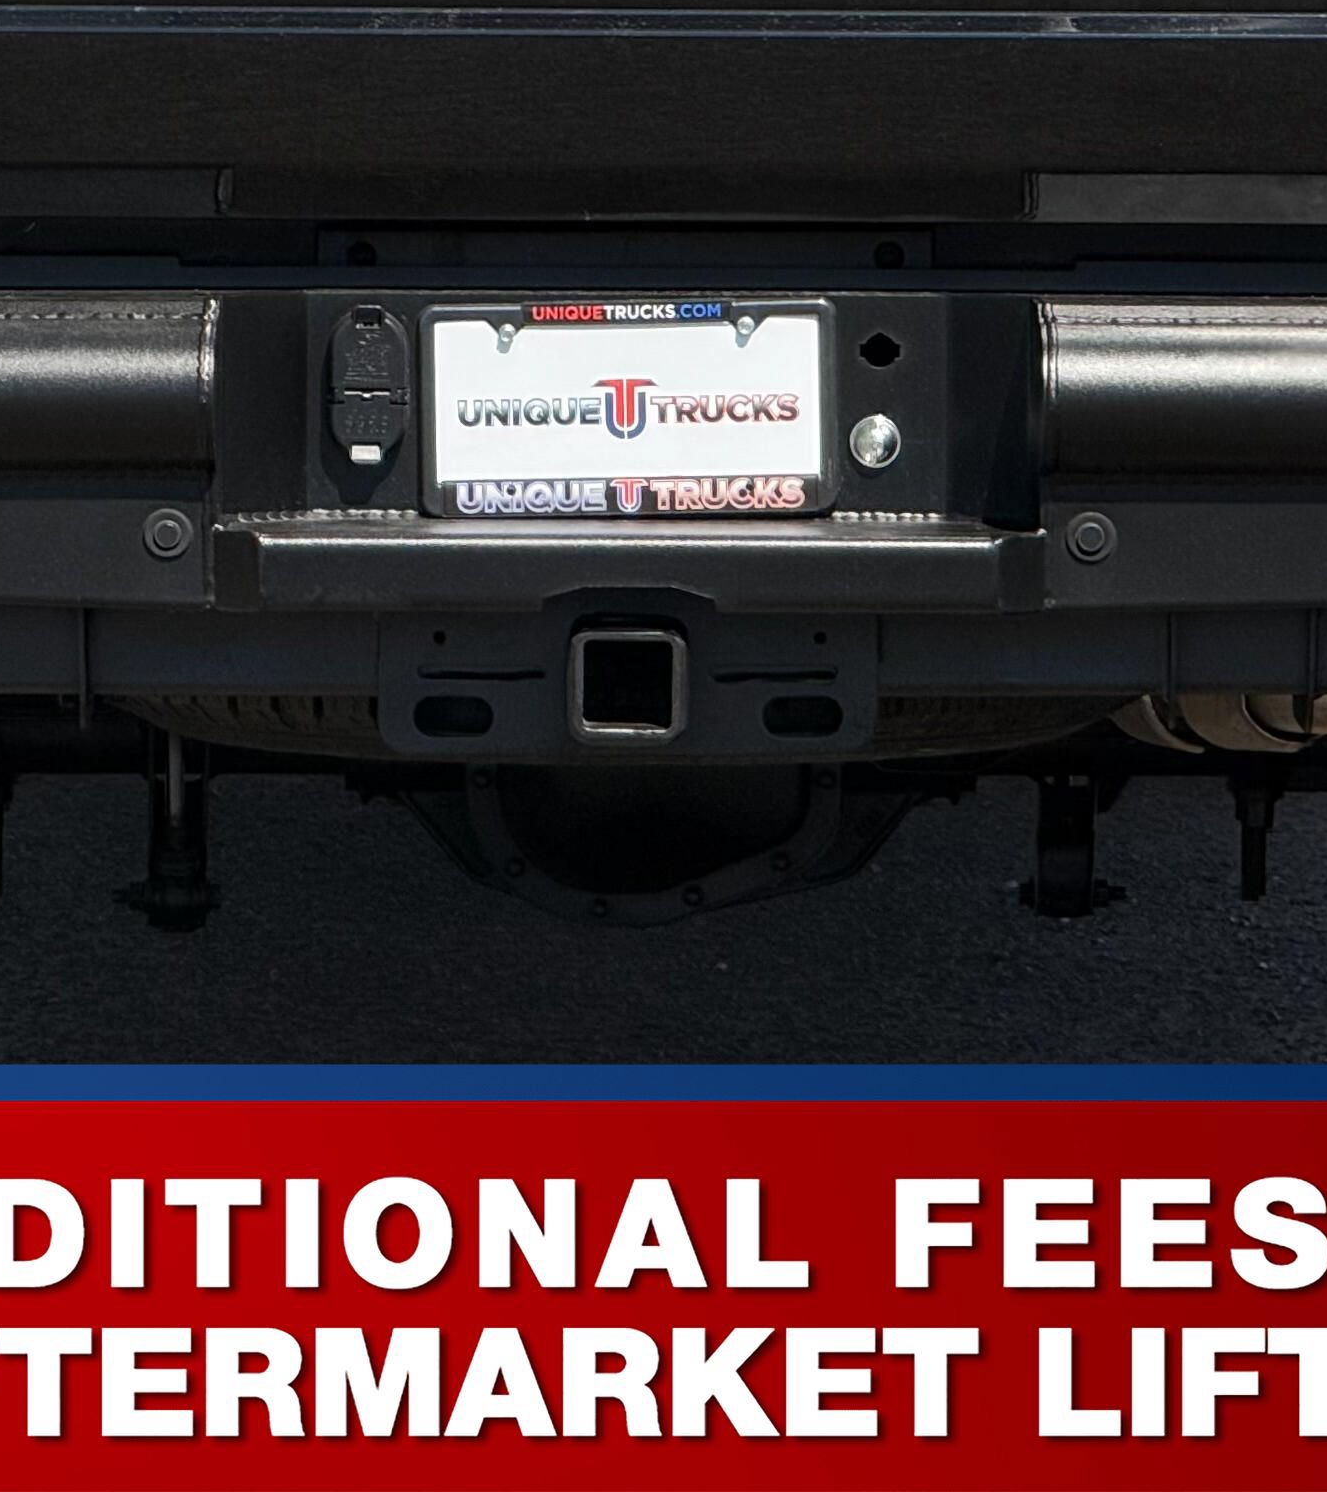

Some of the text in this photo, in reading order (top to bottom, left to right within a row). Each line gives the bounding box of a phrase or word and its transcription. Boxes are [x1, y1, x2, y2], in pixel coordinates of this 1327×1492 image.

[531, 303, 722, 322] UNIQUETRUCKS.COM
[457, 396, 602, 427] UNIQUE
[650, 393, 800, 425] TRUCKS
[456, 478, 608, 515] UNIQUE
[650, 476, 806, 511] TRUCKS
